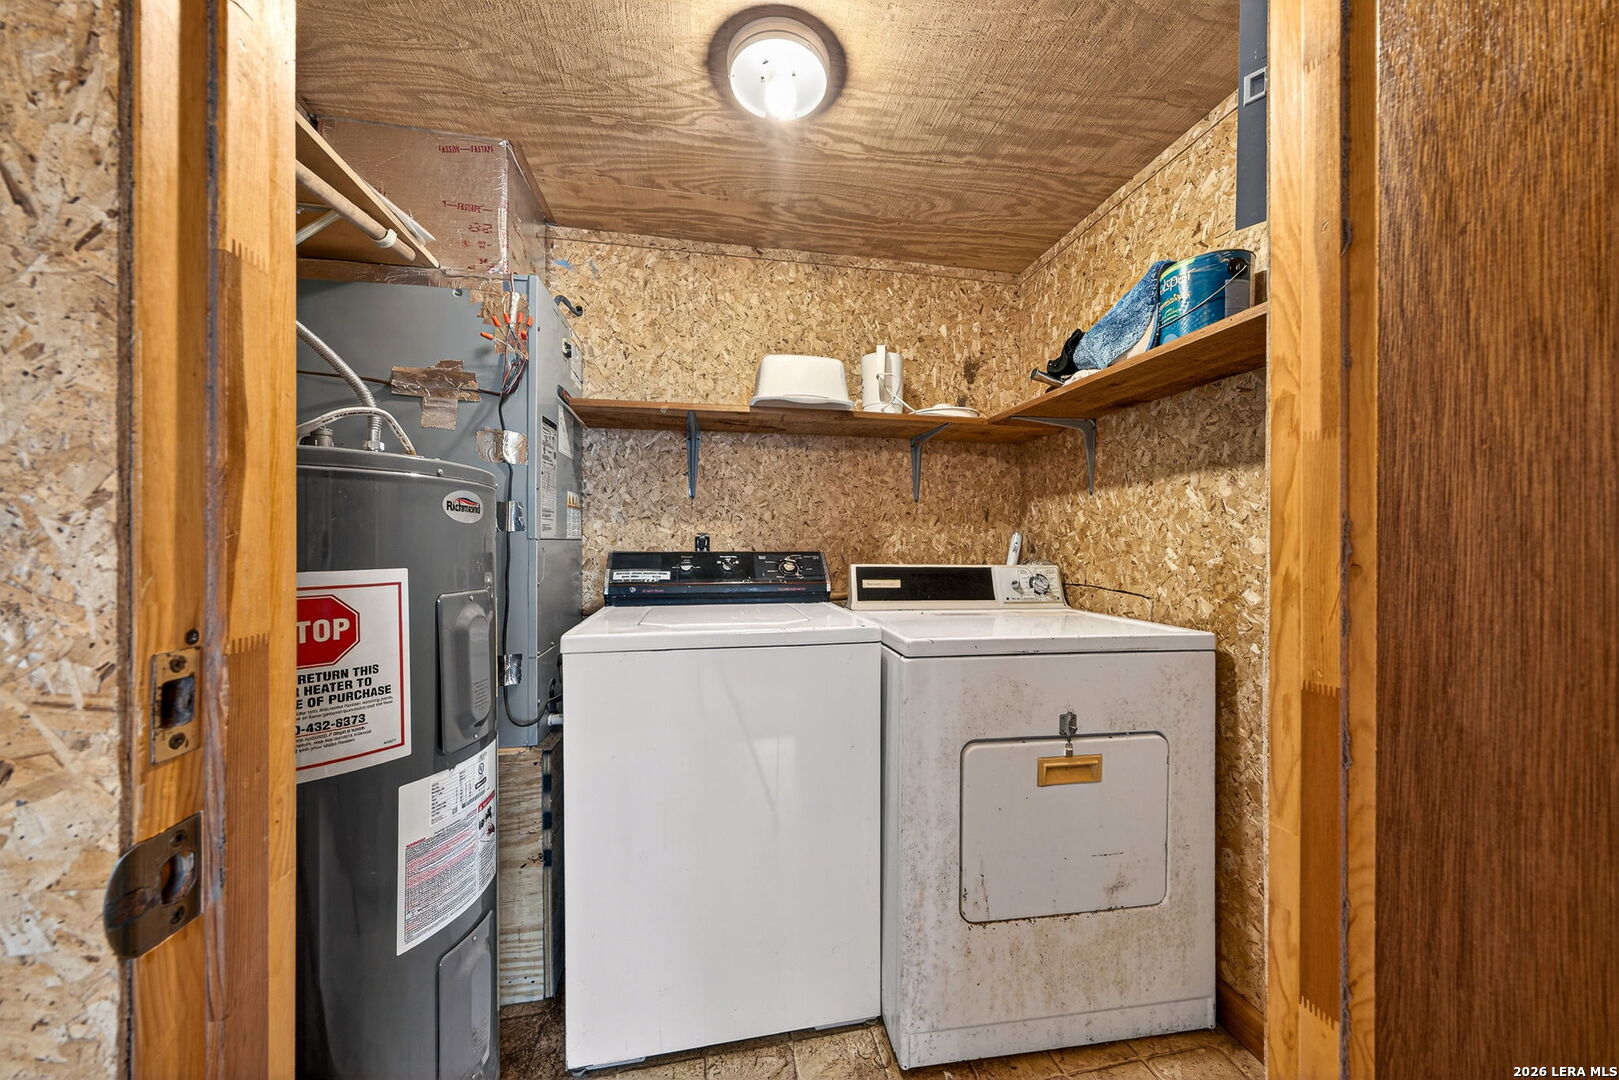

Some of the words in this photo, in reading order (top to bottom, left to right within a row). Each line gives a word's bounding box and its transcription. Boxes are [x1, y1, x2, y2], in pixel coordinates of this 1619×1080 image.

[446, 500, 481, 514] Richmond
[296, 617, 350, 644] TOP
[297, 668, 349, 685] RETURN
[353, 664, 379, 677] THIS
[303, 679, 353, 697] HEATER
[356, 677, 373, 688] TO
[307, 696, 324, 708] OF
[328, 683, 392, 705] PURCHASE
